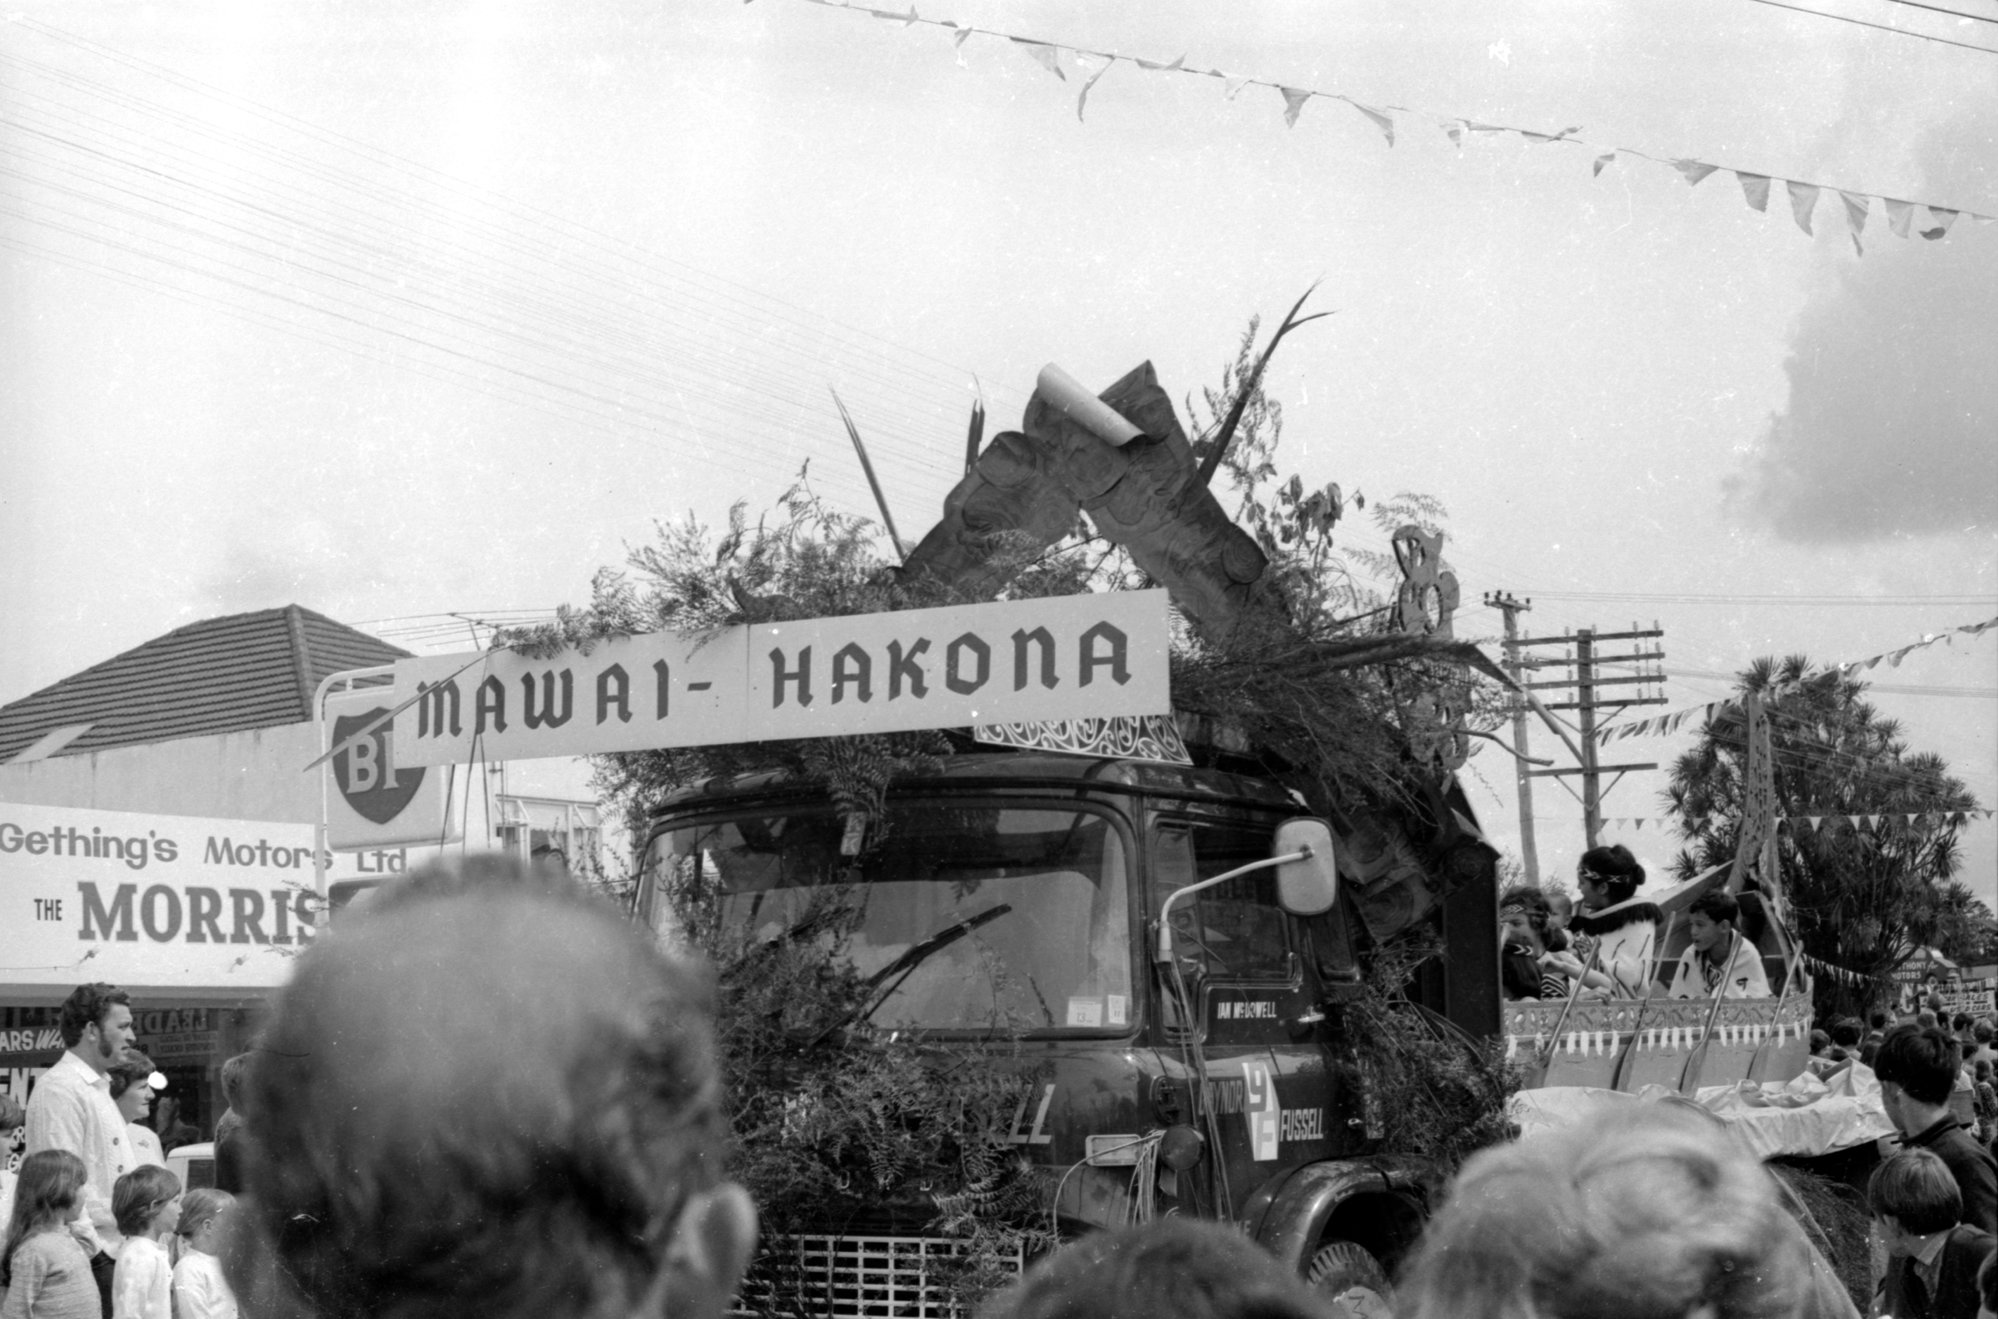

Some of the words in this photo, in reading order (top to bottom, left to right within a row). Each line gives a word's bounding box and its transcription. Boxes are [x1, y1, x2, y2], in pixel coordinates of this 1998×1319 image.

[768, 620, 1132, 709] HAKONA
[0, 823, 178, 870] Gething's
[203, 836, 334, 870] Motors
[356, 847, 407, 874] Ltd
[34, 898, 62, 921] THE
[1897, 960, 1927, 971] THONY
[1217, 1002, 1231, 1019] IAN
[34, 1028, 65, 1050] WA
[1279, 1107, 1324, 1142] FUSSELL
